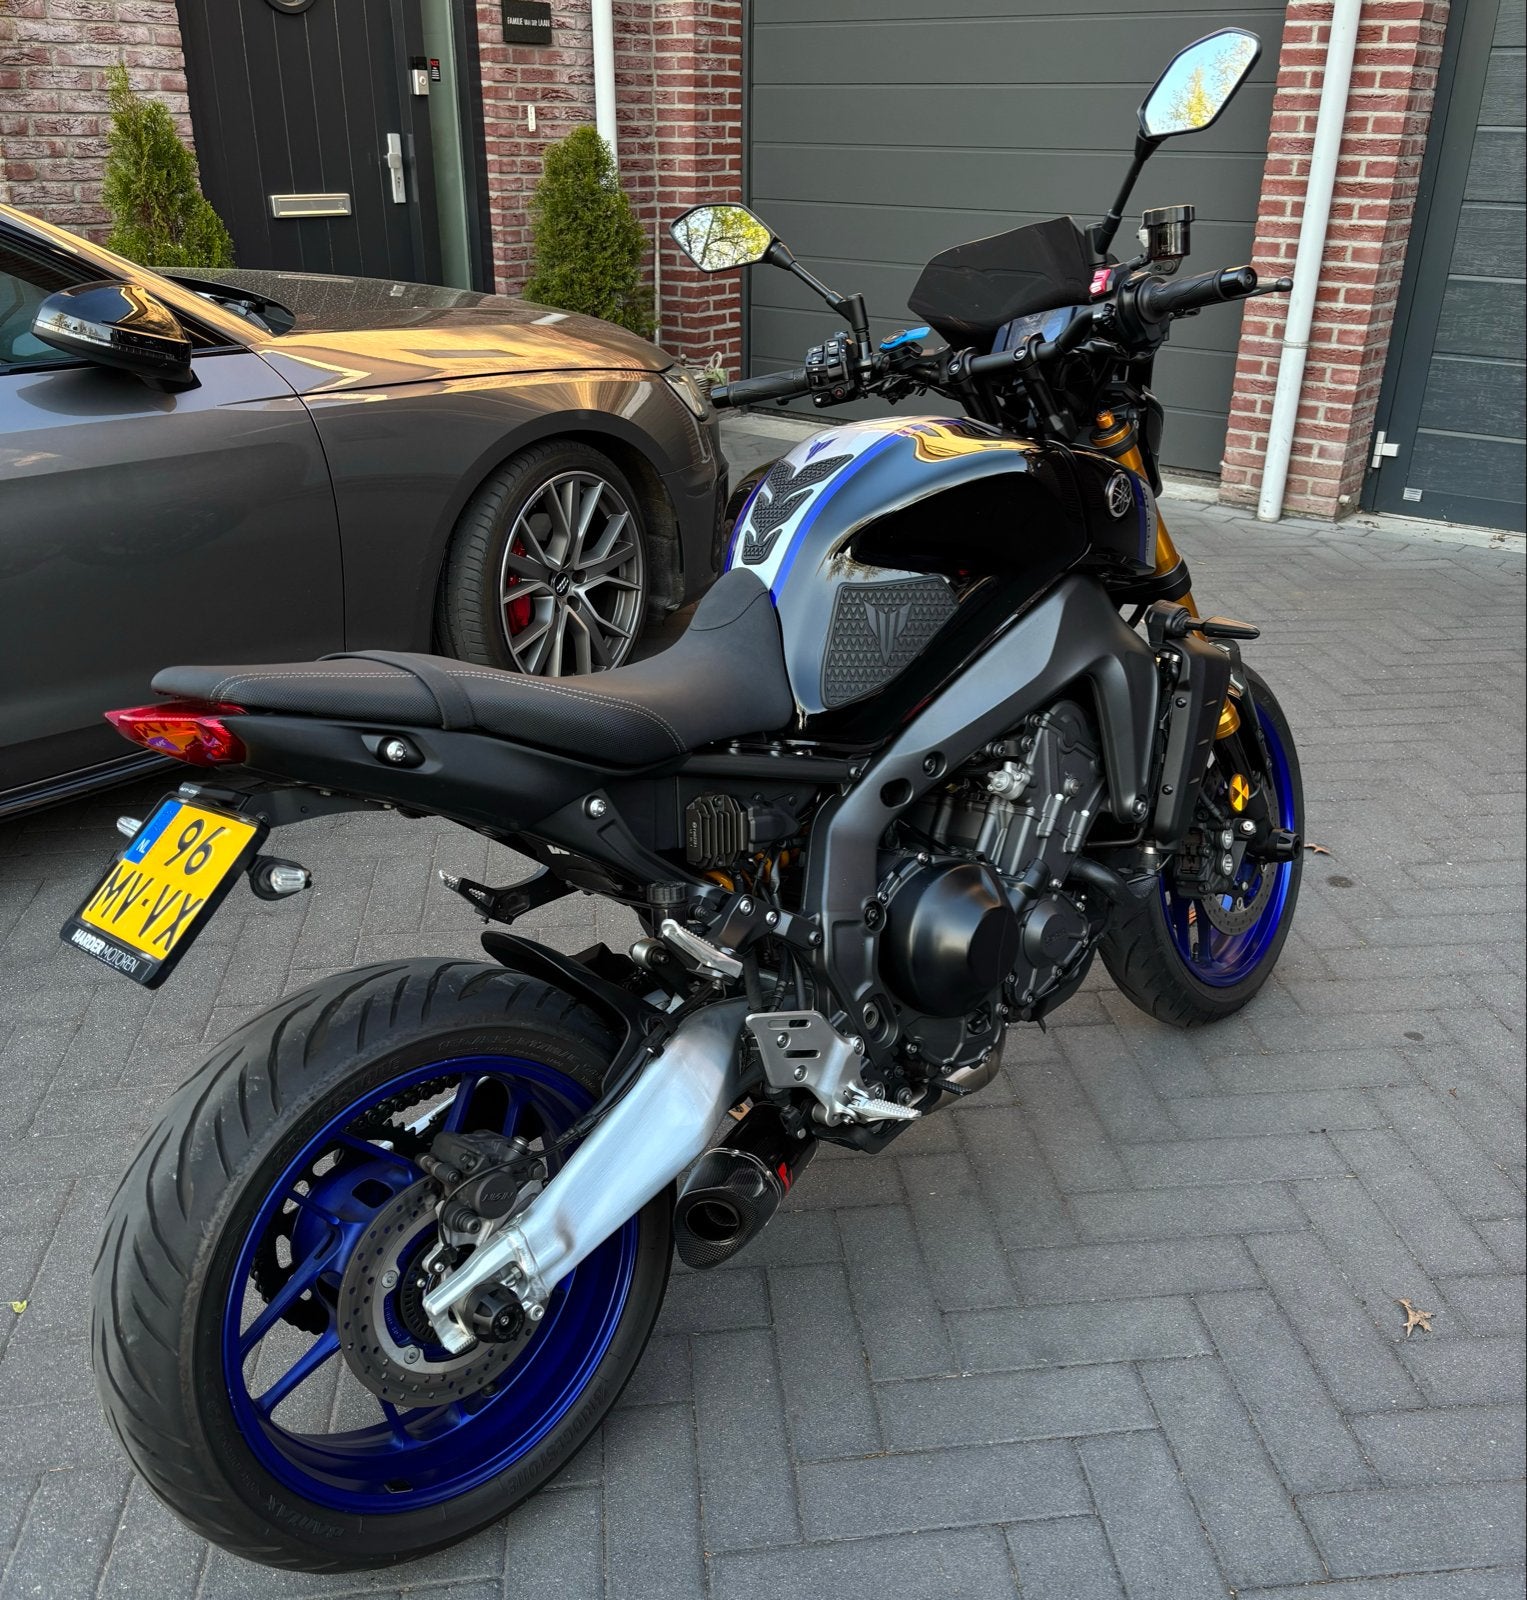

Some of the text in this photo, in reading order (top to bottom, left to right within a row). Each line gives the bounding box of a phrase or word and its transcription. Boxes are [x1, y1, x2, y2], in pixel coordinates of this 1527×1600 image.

[136, 838, 150, 854] NL
[164, 818, 226, 875] 96
[71, 928, 106, 955] HARDER
[100, 944, 140, 973] MOTOREN
